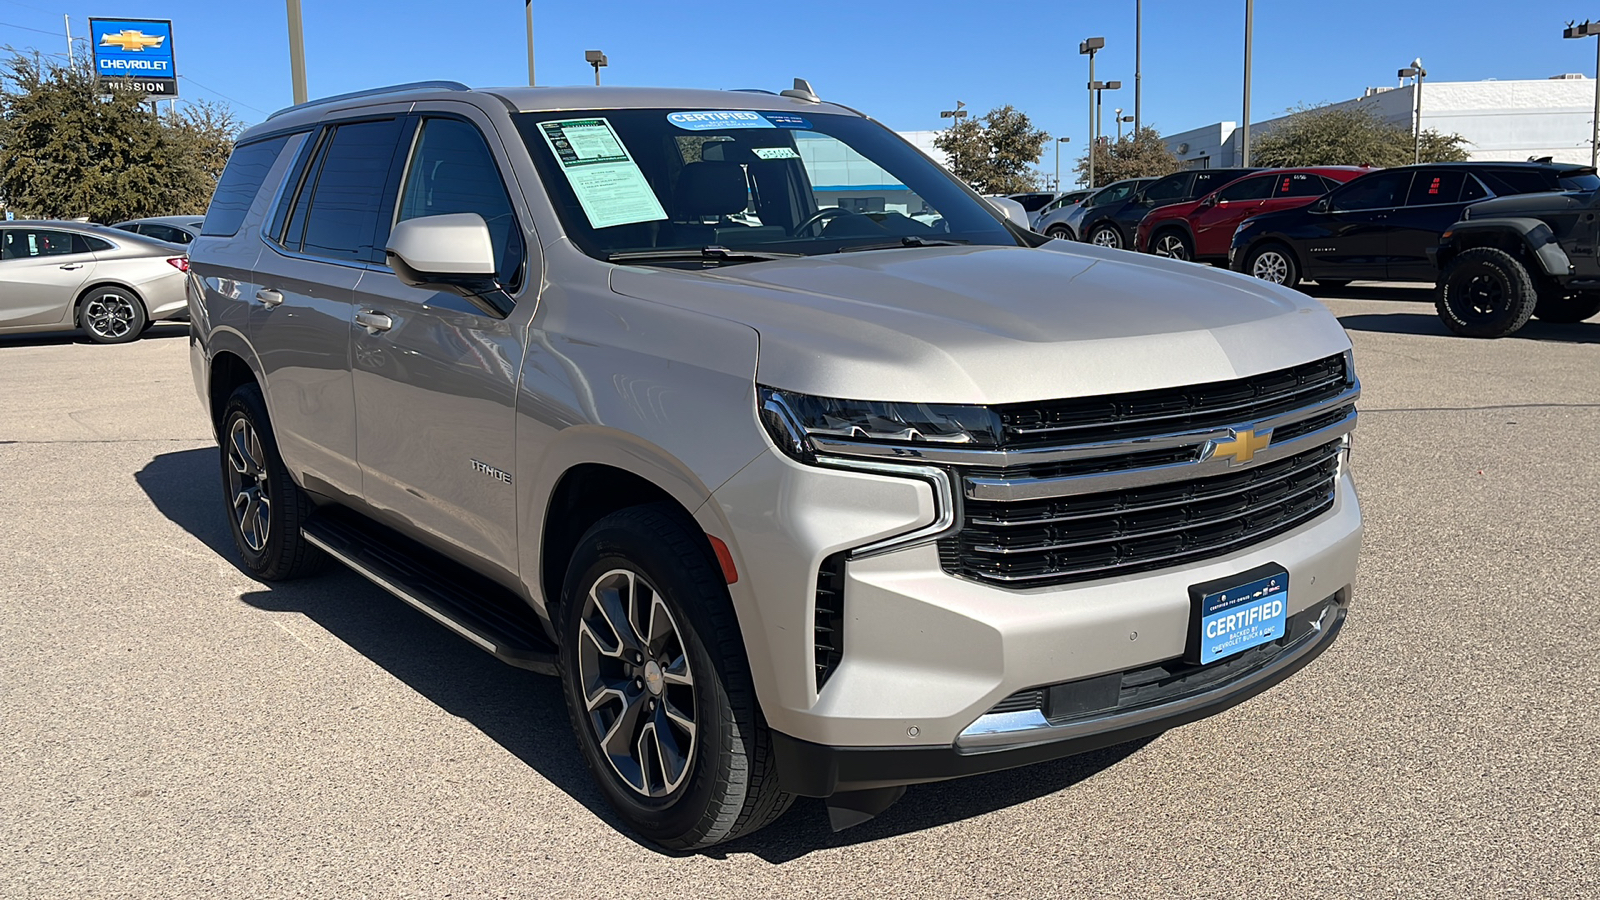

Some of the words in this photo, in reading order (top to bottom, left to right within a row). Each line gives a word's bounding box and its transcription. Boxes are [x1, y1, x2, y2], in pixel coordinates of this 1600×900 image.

[100, 59, 168, 70] CHEVROLET
[108, 82, 165, 92] MISSION
[671, 112, 759, 122] CERTIFIED
[469, 458, 512, 485] TAHOE
[1209, 602, 1228, 611] CERTIFIED
[1206, 600, 1283, 639] CERTIFIED
[1211, 637, 1242, 653] CHEVROLET
[1243, 631, 1258, 642] BUICK
[1264, 626, 1275, 634] GMC
[1229, 628, 1250, 640] BACKED
